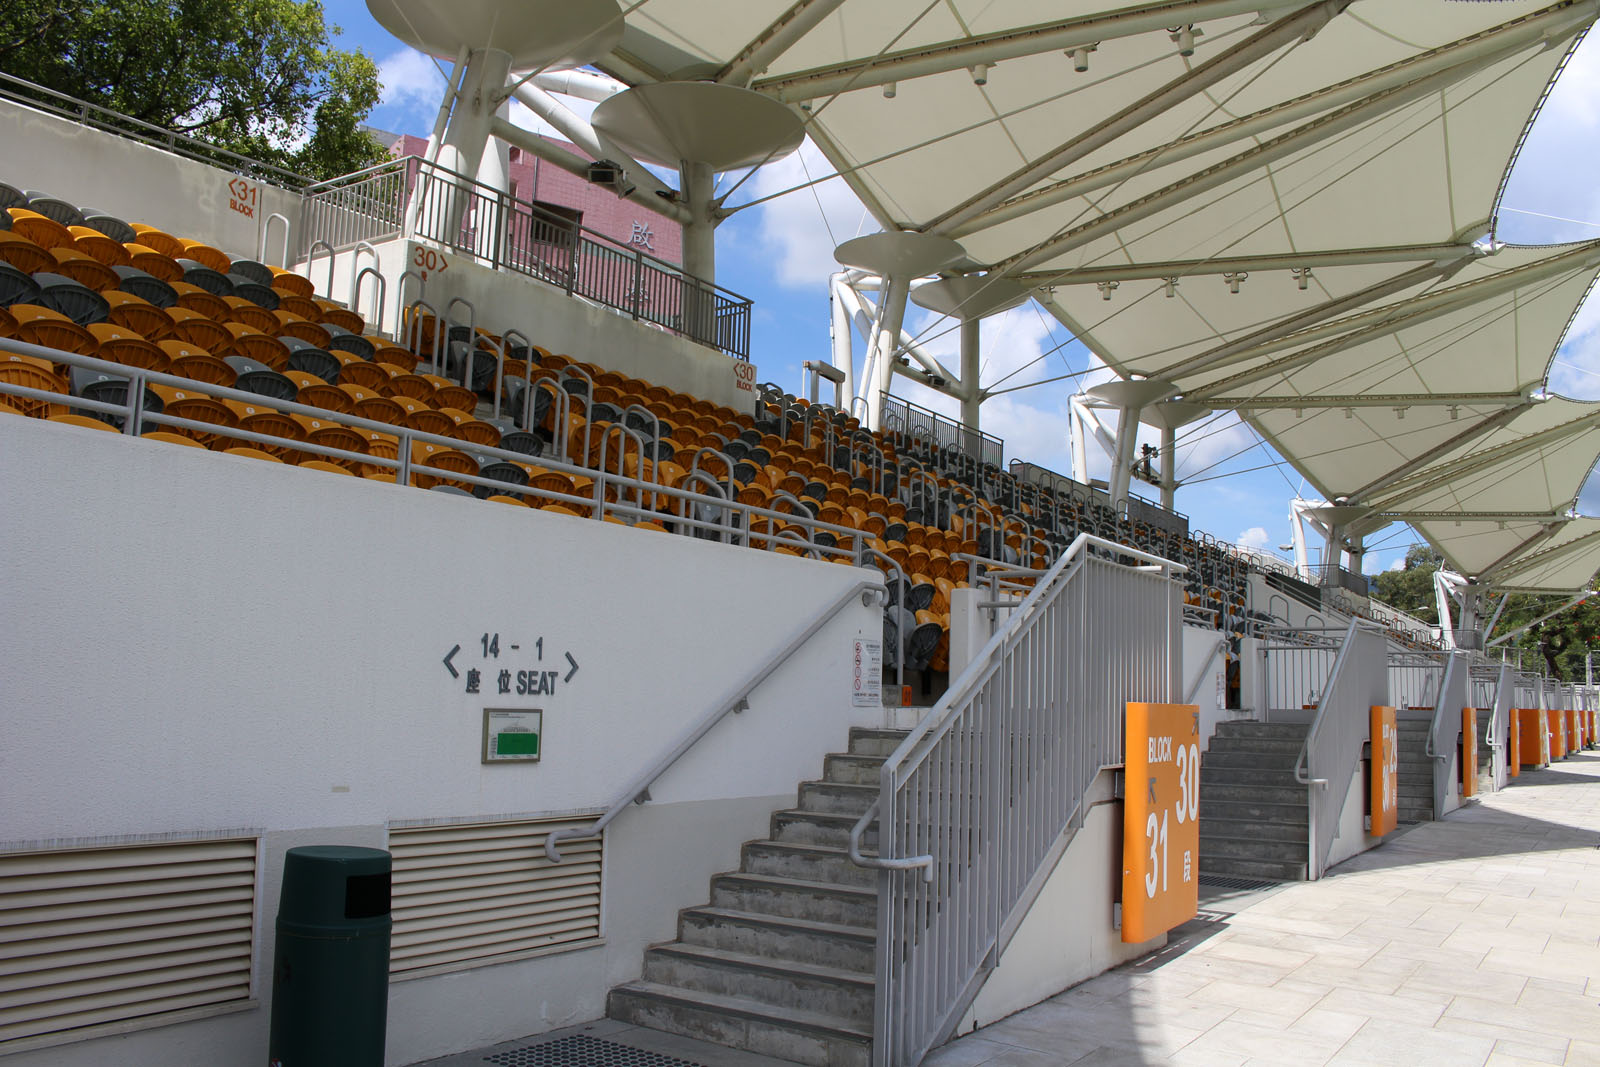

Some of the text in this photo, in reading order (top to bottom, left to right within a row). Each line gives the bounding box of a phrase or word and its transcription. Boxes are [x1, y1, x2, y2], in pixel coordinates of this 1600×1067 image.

[237, 180, 257, 206] 31
[229, 198, 253, 219] BLOCK
[414, 246, 437, 271] 30
[736, 379, 753, 392] BLOCK
[740, 363, 753, 382] 30
[480, 632, 500, 658] 14
[535, 636, 544, 661] 1
[516, 670, 559, 696] SEAT
[1148, 736, 1173, 764] BLOCK
[1175, 743, 1200, 825] 30
[1145, 809, 1168, 900] 31
